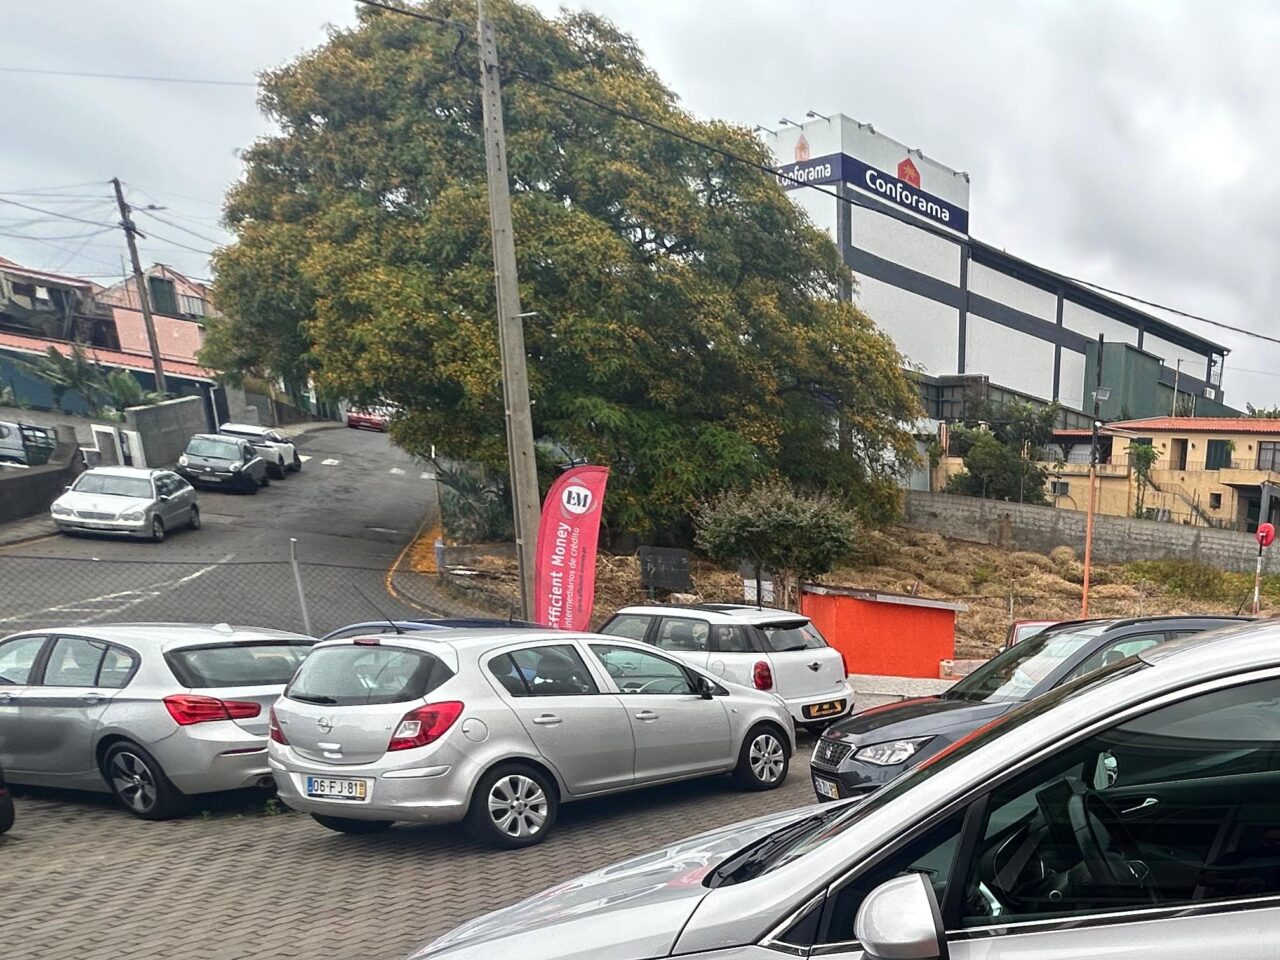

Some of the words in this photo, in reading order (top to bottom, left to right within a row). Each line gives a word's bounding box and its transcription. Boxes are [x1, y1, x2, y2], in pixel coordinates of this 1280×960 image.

[776, 163, 831, 187] Conforama
[865, 170, 950, 222] Conforama
[566, 490, 589, 508] EM
[551, 522, 571, 566] Money
[569, 527, 580, 556] crédito
[568, 558, 577, 569] de
